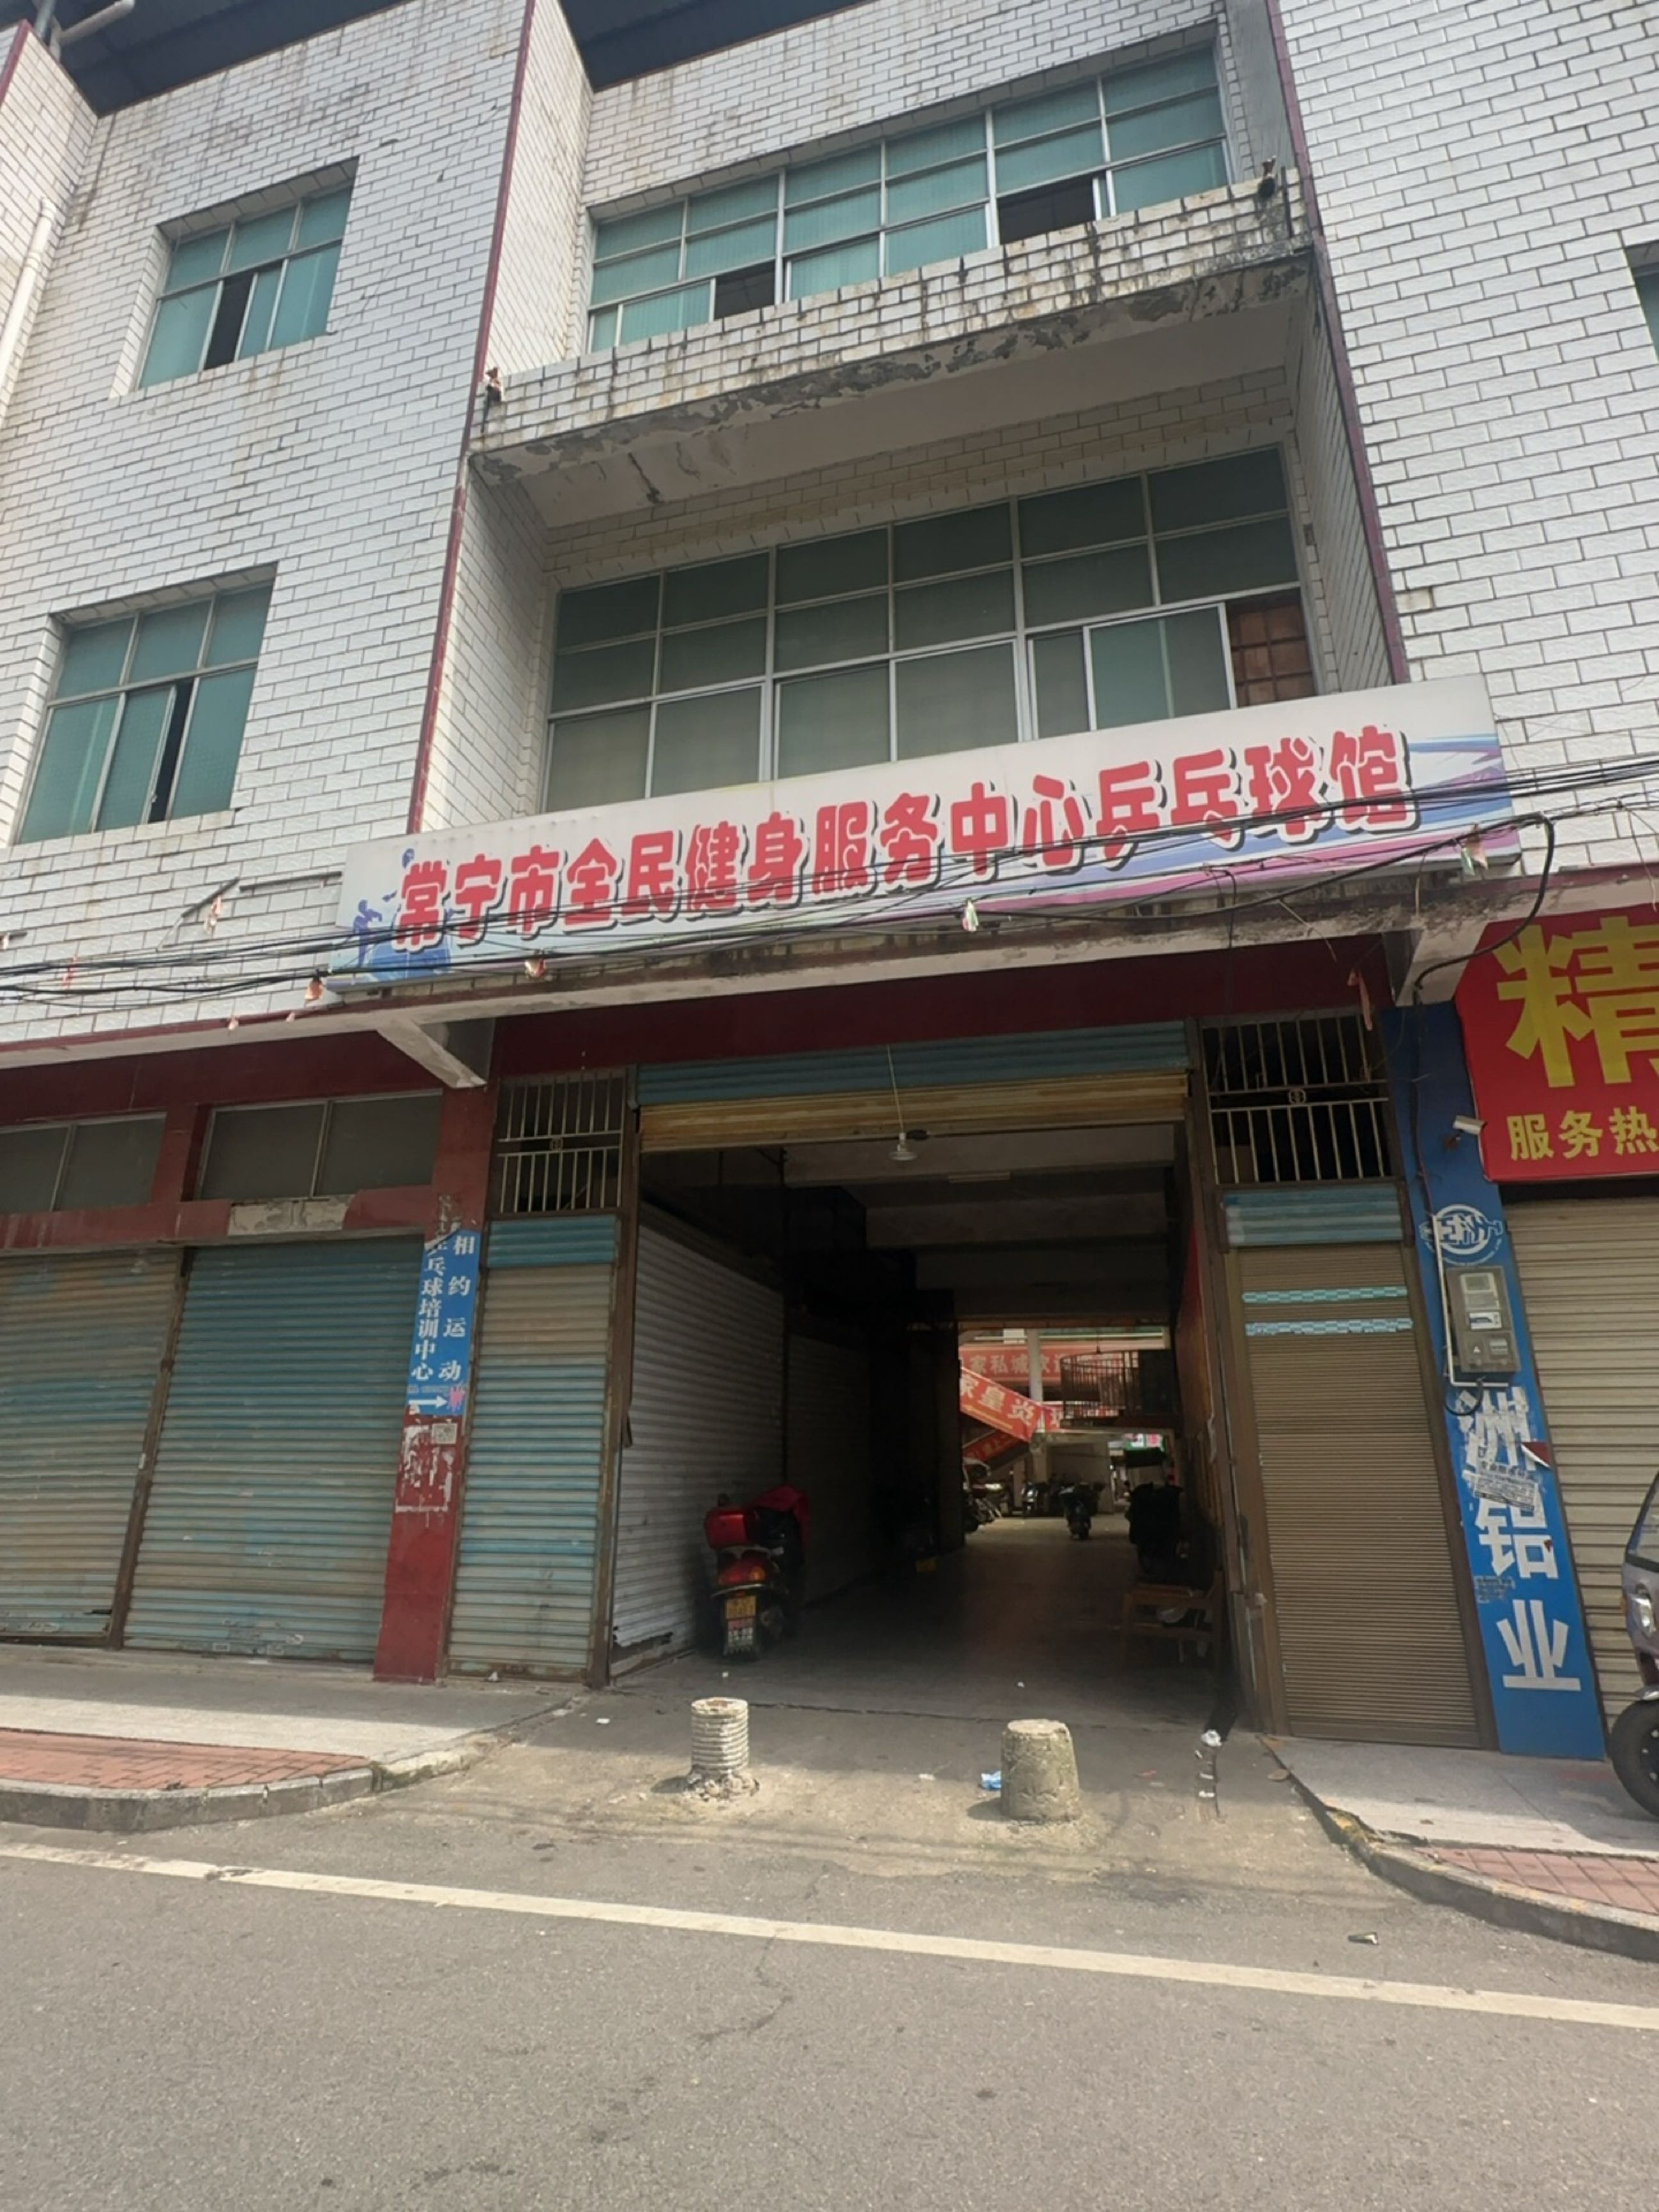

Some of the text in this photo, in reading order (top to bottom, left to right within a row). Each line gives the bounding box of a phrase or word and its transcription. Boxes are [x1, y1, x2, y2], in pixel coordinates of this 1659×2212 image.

[393, 725, 1412, 950] 常宁市全民健身服务中心乒乓球馆
[1493, 915, 1659, 1088] 精
[1506, 1105, 1659, 1160] 服务热
[439, 1236, 475, 1381] 相约运动
